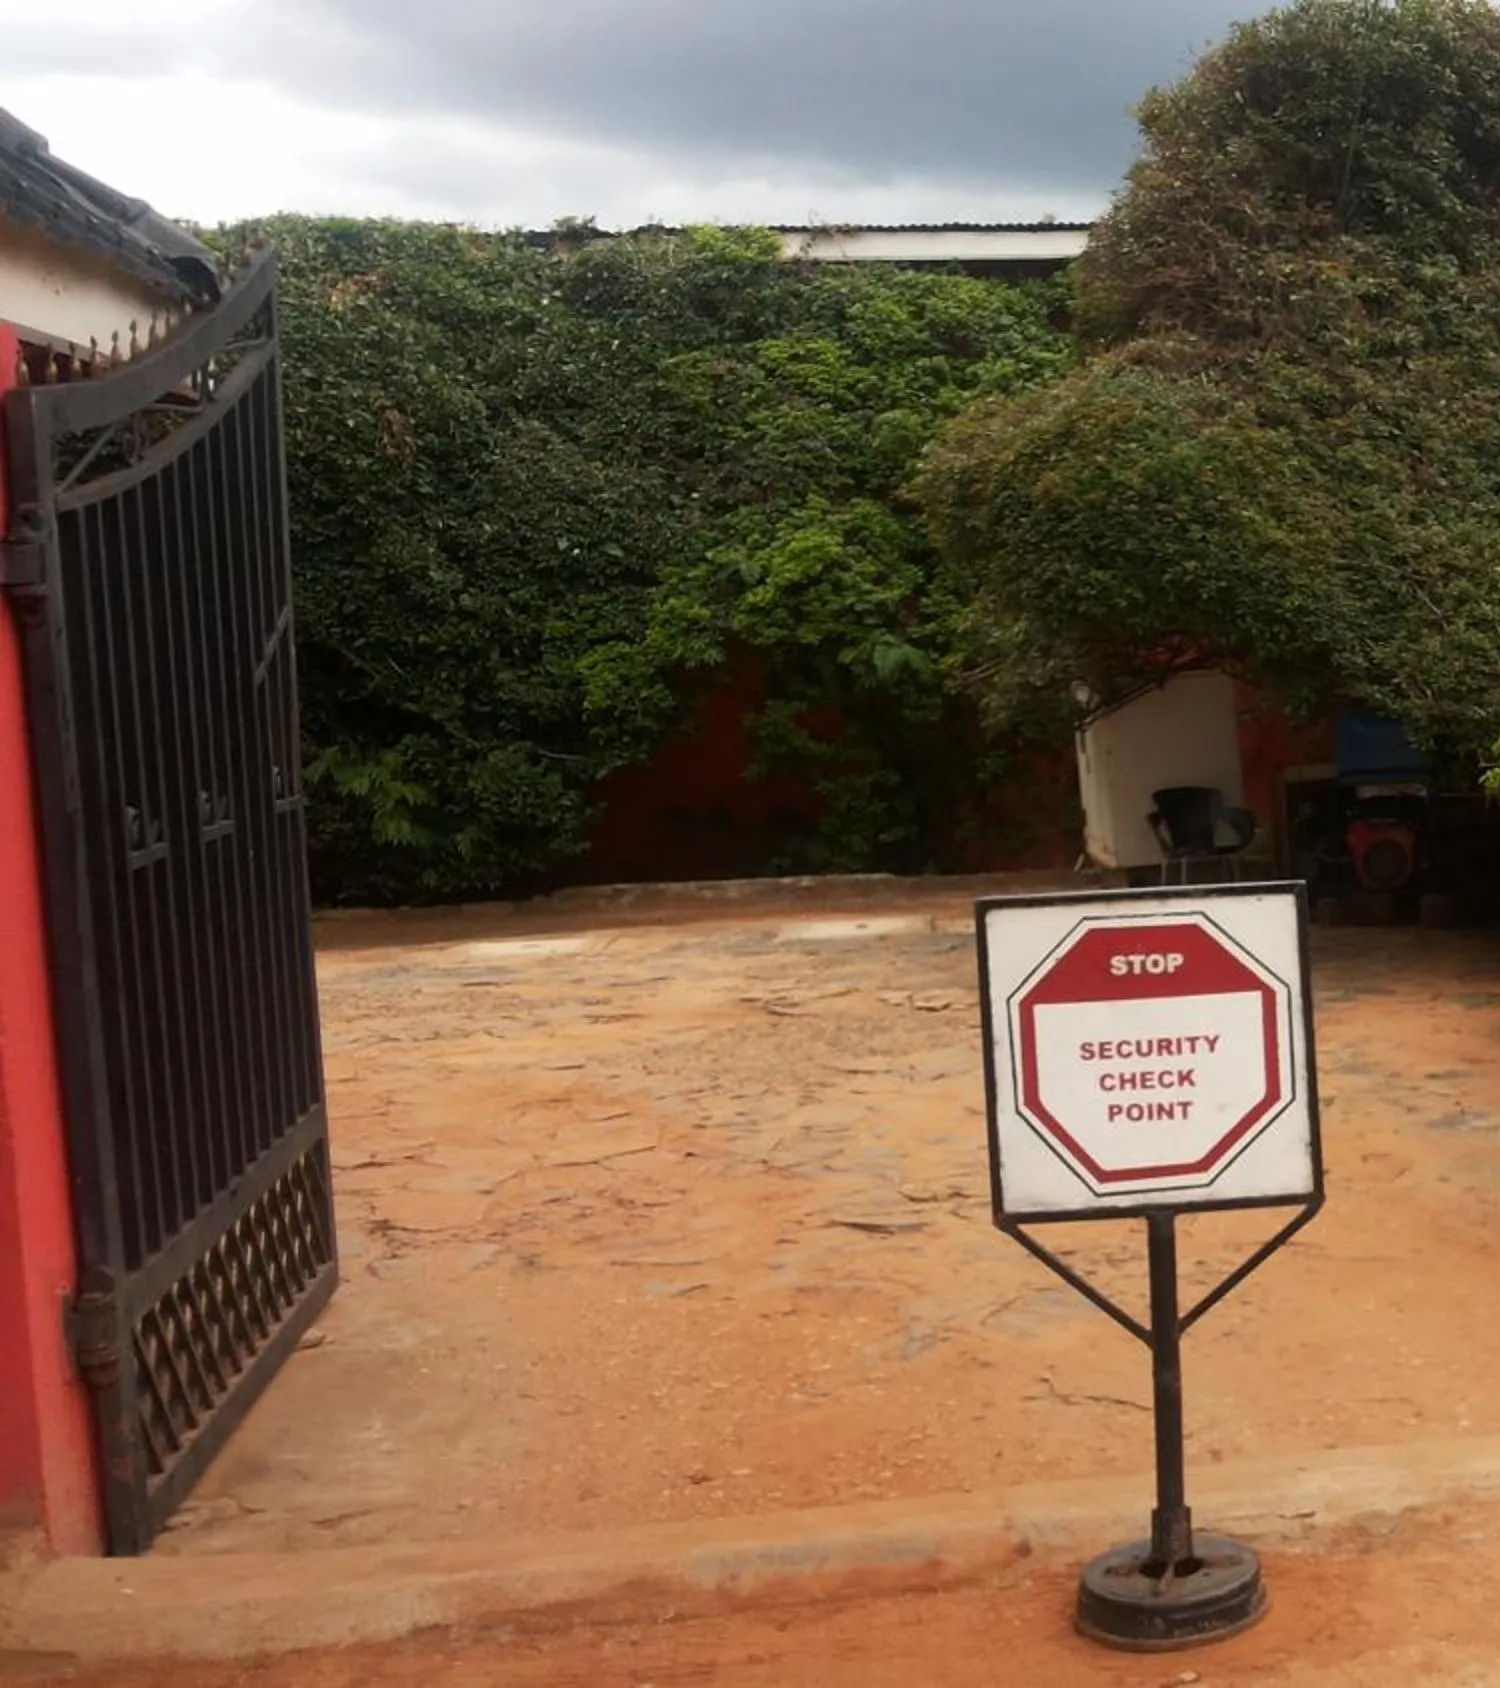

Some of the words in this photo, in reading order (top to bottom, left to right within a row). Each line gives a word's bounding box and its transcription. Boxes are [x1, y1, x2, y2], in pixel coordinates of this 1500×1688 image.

[1109, 954, 1185, 976] STOP
[1079, 1034, 1221, 1061] SECURITY
[1099, 1069, 1197, 1092] CHECK
[1107, 1101, 1194, 1123] POINT
